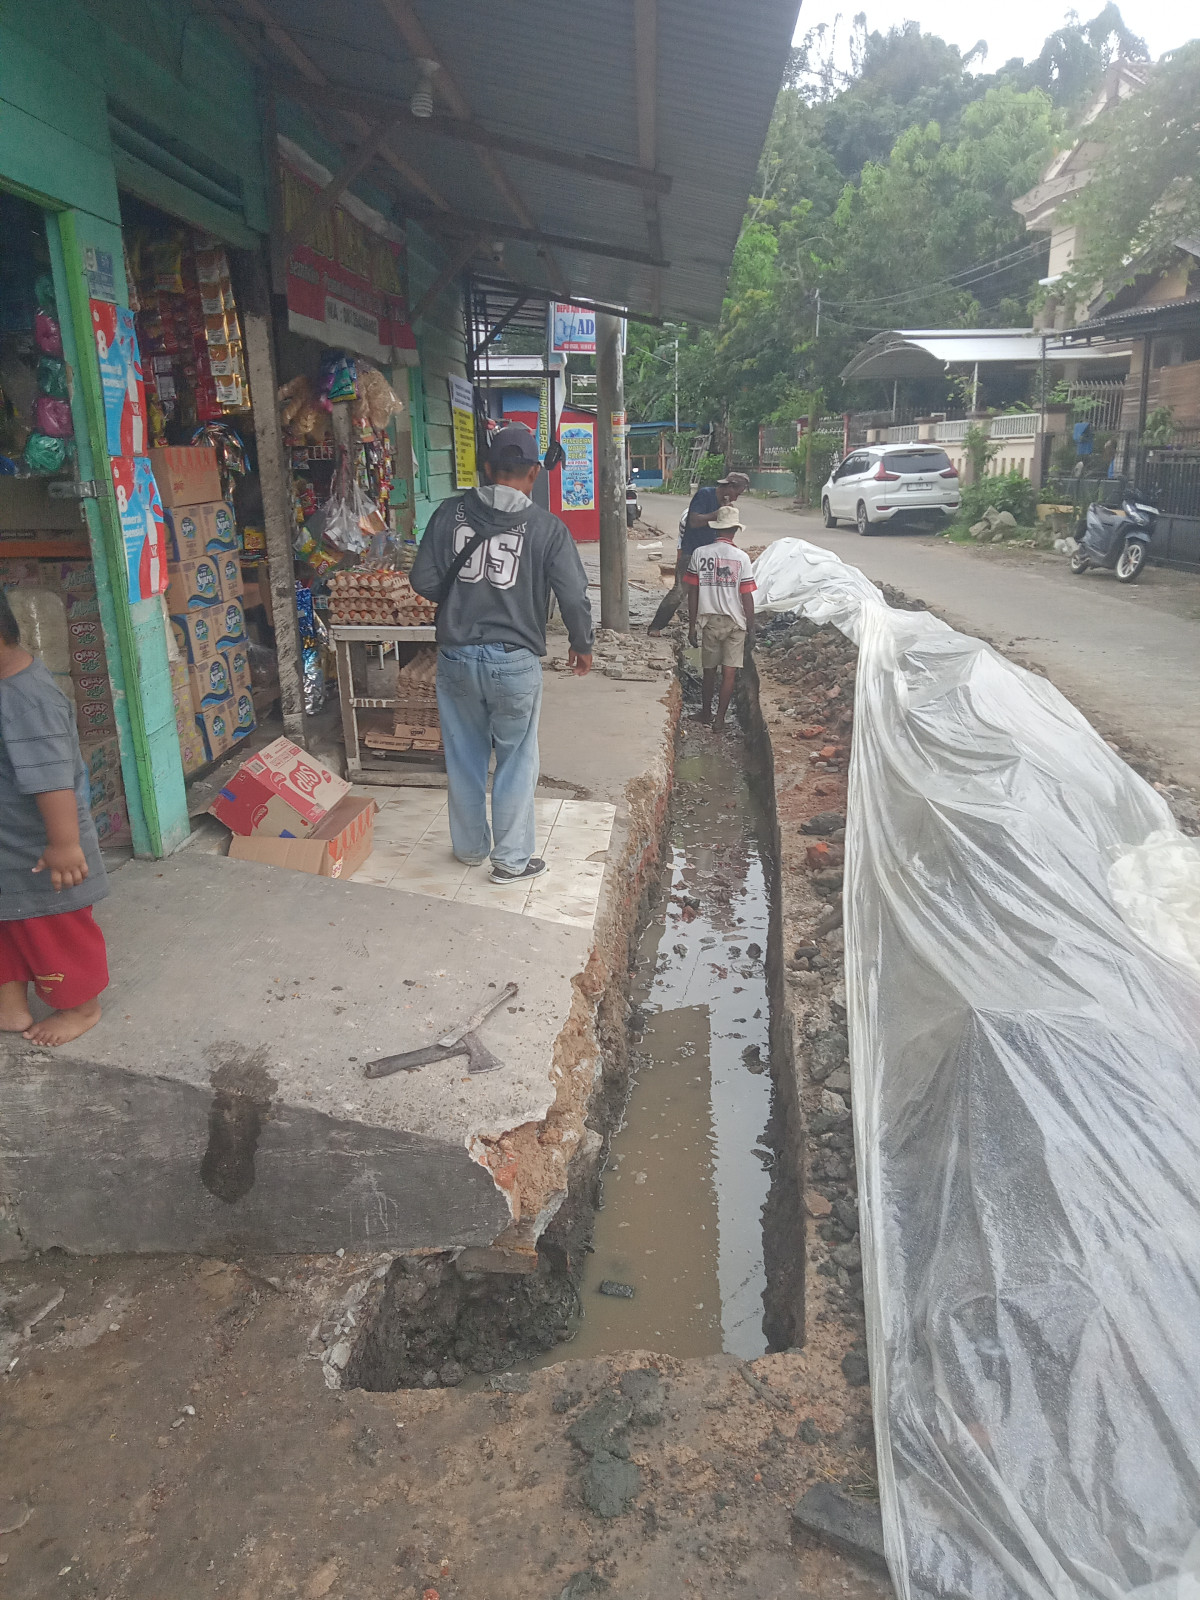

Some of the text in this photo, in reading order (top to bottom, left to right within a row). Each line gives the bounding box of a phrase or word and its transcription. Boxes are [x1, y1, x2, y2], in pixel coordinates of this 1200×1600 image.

[540, 388, 548, 407] AIR
[540, 408, 548, 454] MINERAL
[453, 522, 524, 590] 95
[700, 558, 714, 571] 26
